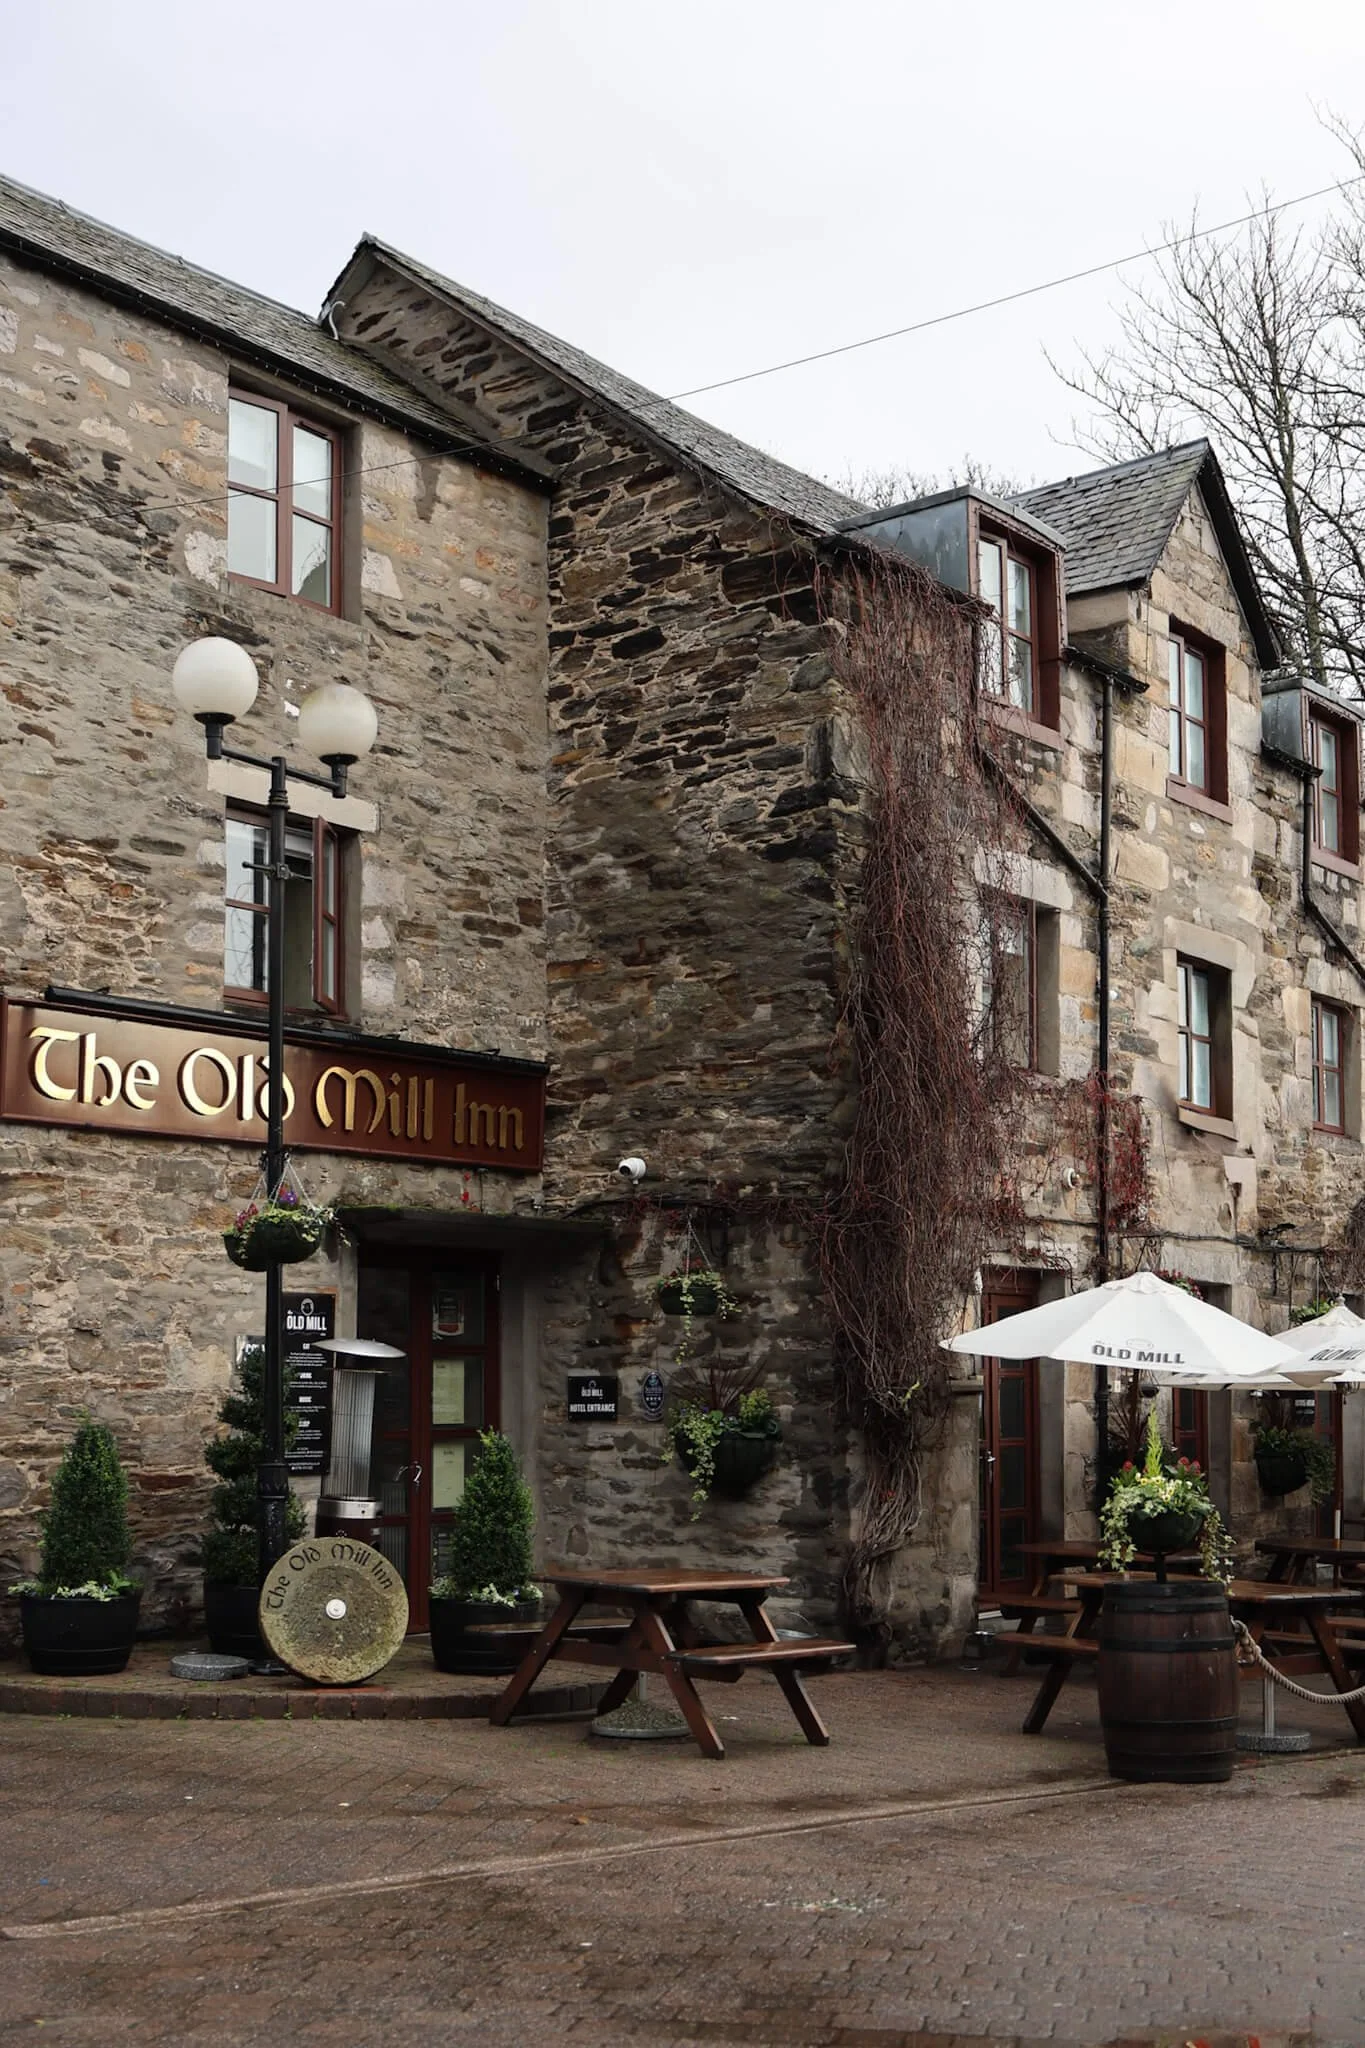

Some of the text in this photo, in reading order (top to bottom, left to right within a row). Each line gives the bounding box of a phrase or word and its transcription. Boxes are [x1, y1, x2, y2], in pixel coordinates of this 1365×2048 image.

[26, 1026, 524, 1151] The Old Mill Inn
[287, 1315, 327, 1331] OLD MILL
[1092, 1344, 1185, 1364] OLD MILL
[587, 1403, 615, 1412] ENTRANCE
[266, 1543, 393, 1609] The Old Mill Inn
